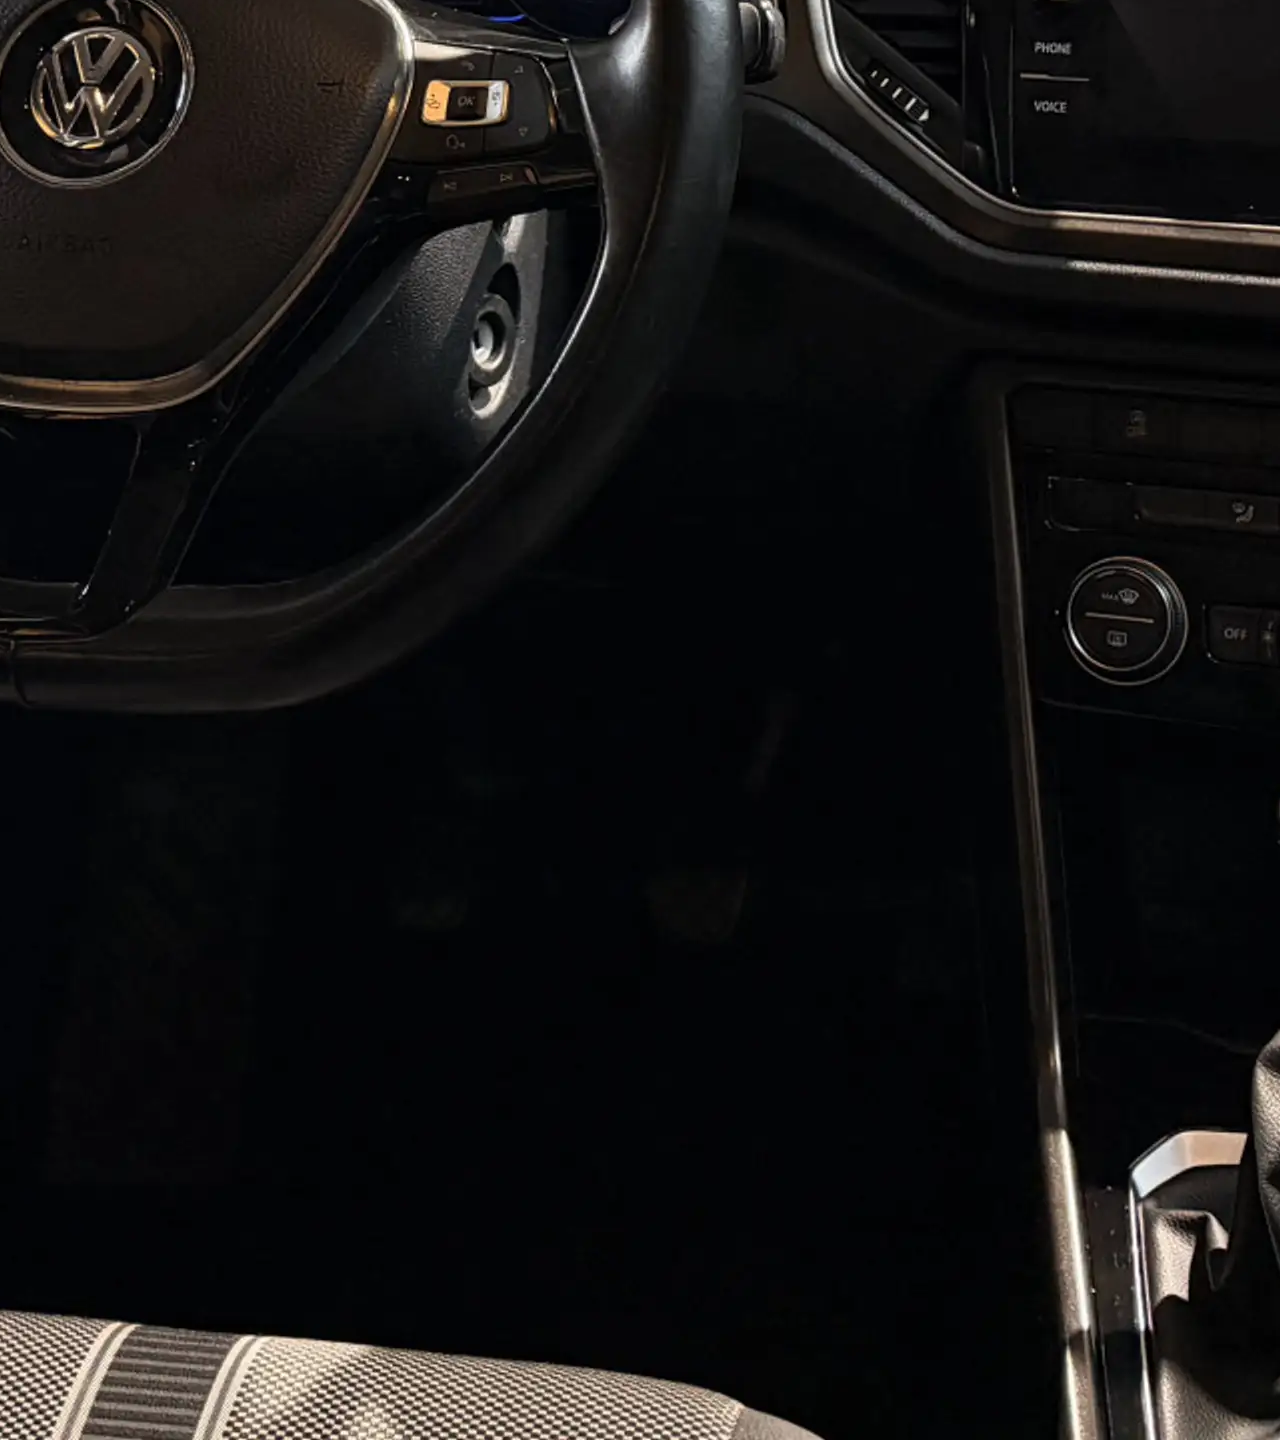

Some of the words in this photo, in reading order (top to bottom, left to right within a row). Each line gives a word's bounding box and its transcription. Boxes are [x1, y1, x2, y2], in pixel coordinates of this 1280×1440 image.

[1034, 42, 1072, 55] PHONE
[457, 95, 475, 107] OK
[1034, 100, 1068, 113] VOICE
[1224, 628, 1248, 640] OFF
